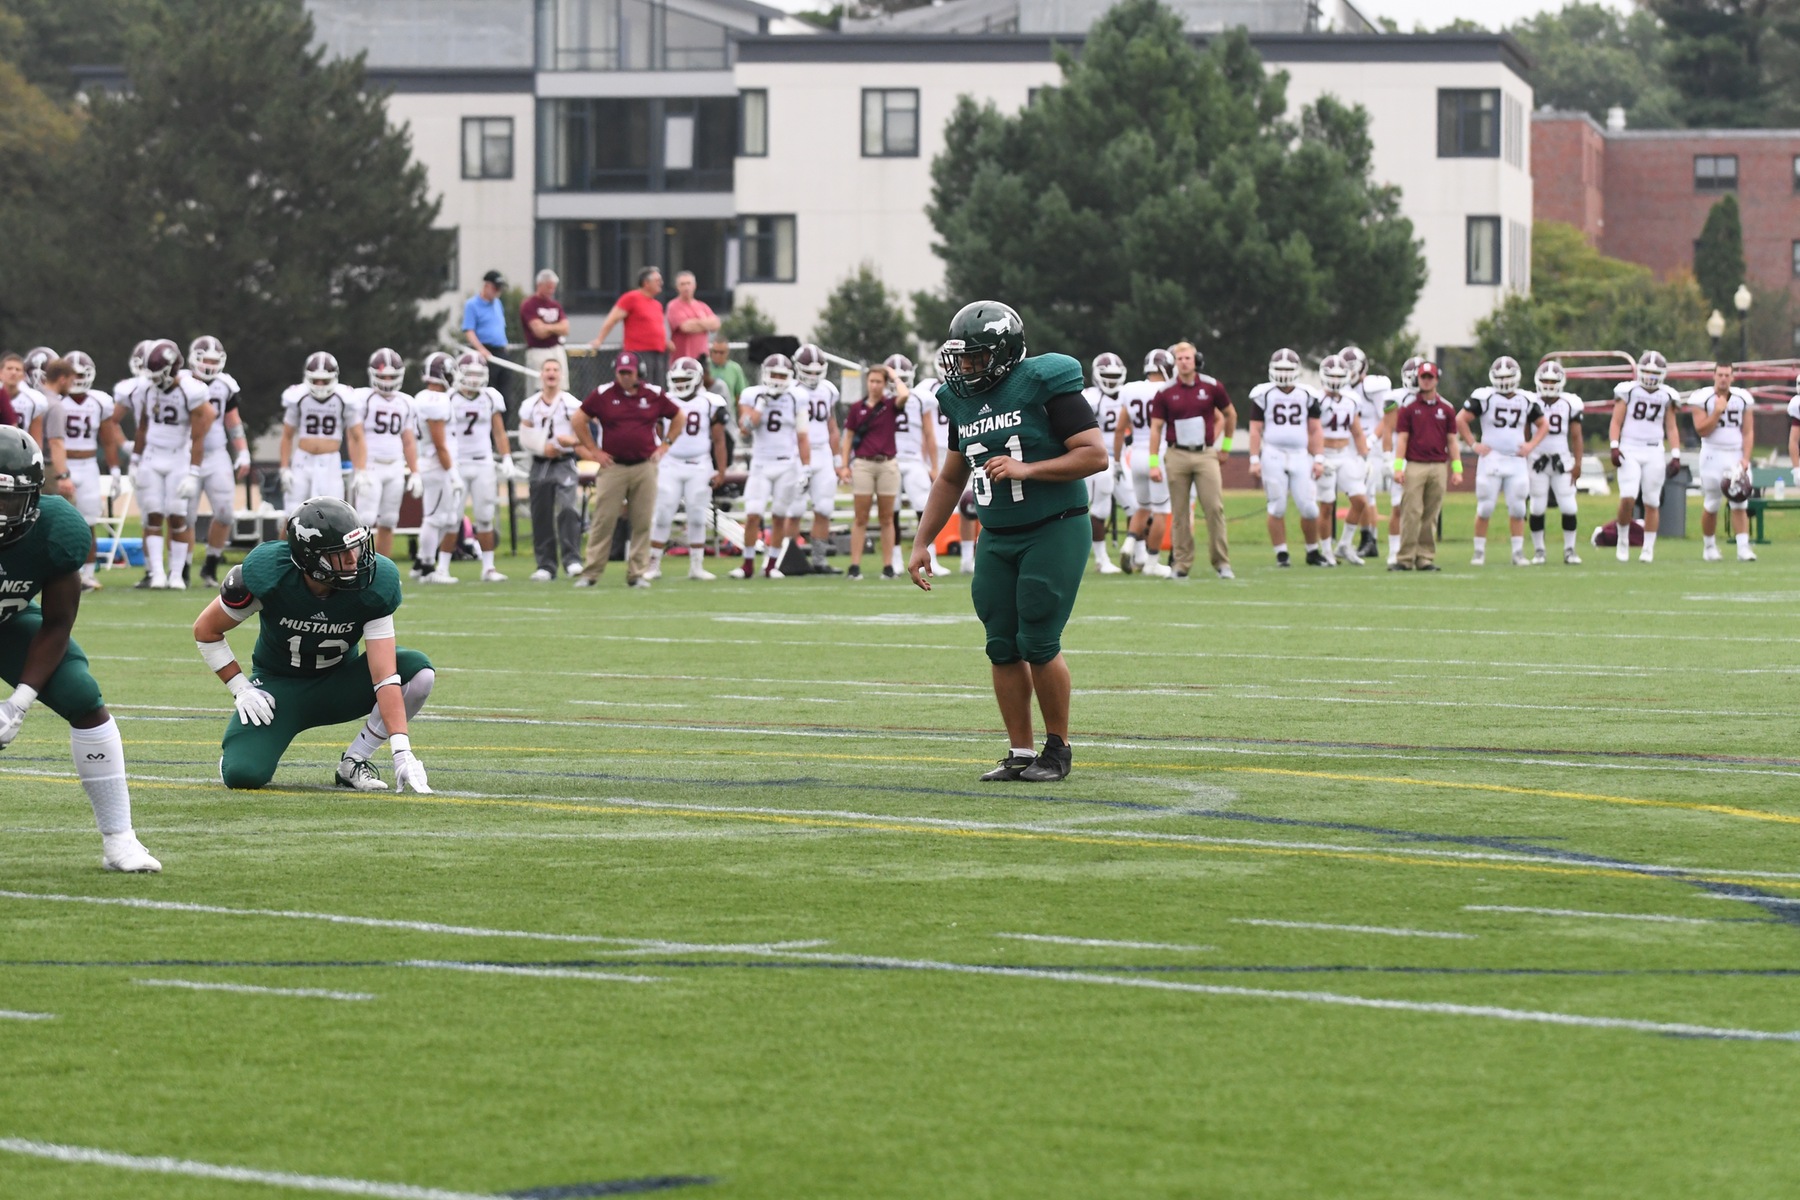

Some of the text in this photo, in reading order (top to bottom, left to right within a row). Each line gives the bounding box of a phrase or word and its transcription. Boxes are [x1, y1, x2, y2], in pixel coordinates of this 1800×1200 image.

[767, 410, 782, 432] 6
[1103, 411, 1116, 432] 2
[1273, 404, 1302, 425] 62
[1494, 407, 1522, 428] 57
[1633, 401, 1661, 422] 87
[66, 415, 92, 438] 51
[306, 414, 337, 435] 29
[374, 411, 402, 434] 50
[463, 411, 478, 435] 7
[958, 410, 1022, 439] MUSTANGS
[965, 435, 1025, 506] 61
[279, 617, 356, 634] MUSTANGS
